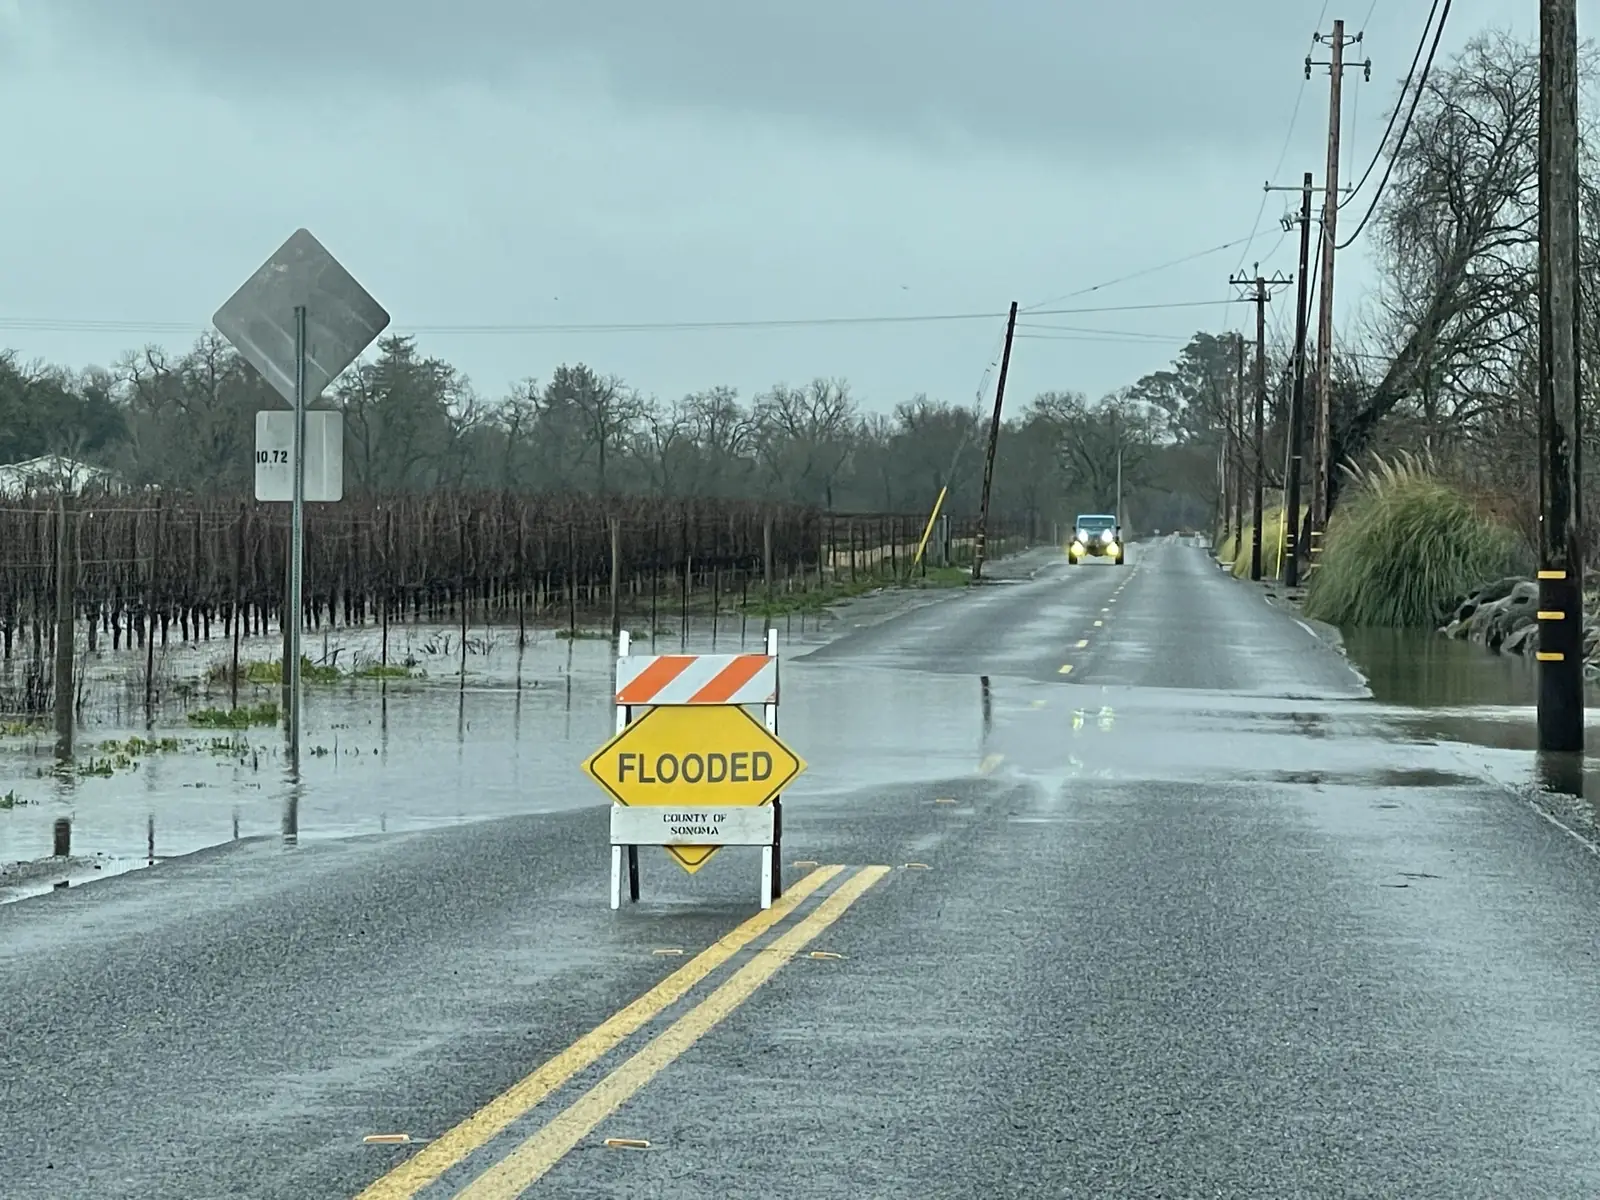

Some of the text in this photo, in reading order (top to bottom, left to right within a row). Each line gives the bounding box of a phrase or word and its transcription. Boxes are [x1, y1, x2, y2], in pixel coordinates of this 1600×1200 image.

[256, 450, 288, 464] 10.72
[618, 751, 773, 784] FLOODED
[663, 813, 728, 823] COUNTY OF
[670, 826, 719, 836] SONOMA
